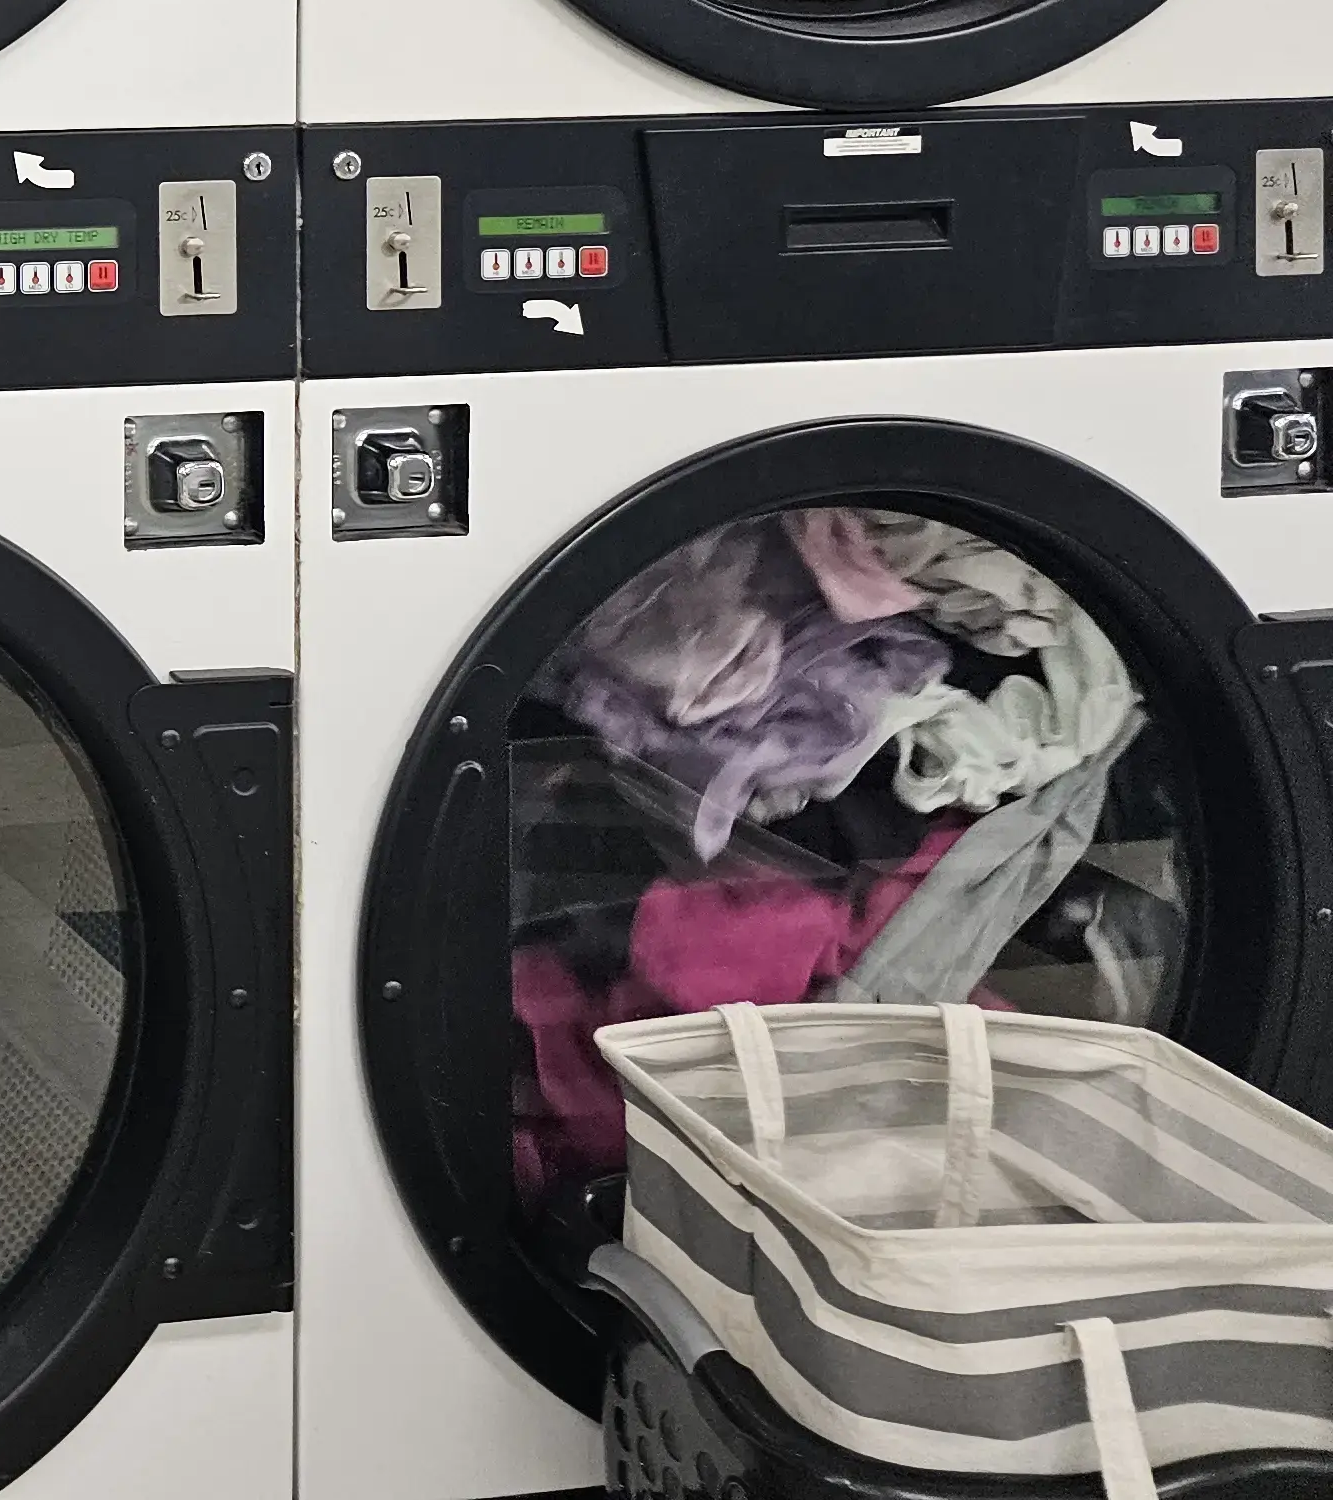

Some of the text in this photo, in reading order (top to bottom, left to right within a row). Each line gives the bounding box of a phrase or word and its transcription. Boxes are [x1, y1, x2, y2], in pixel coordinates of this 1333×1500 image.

[845, 127, 901, 138] IMPORTANT
[33, 231, 59, 244] DRY
[67, 229, 100, 243] TEMP
